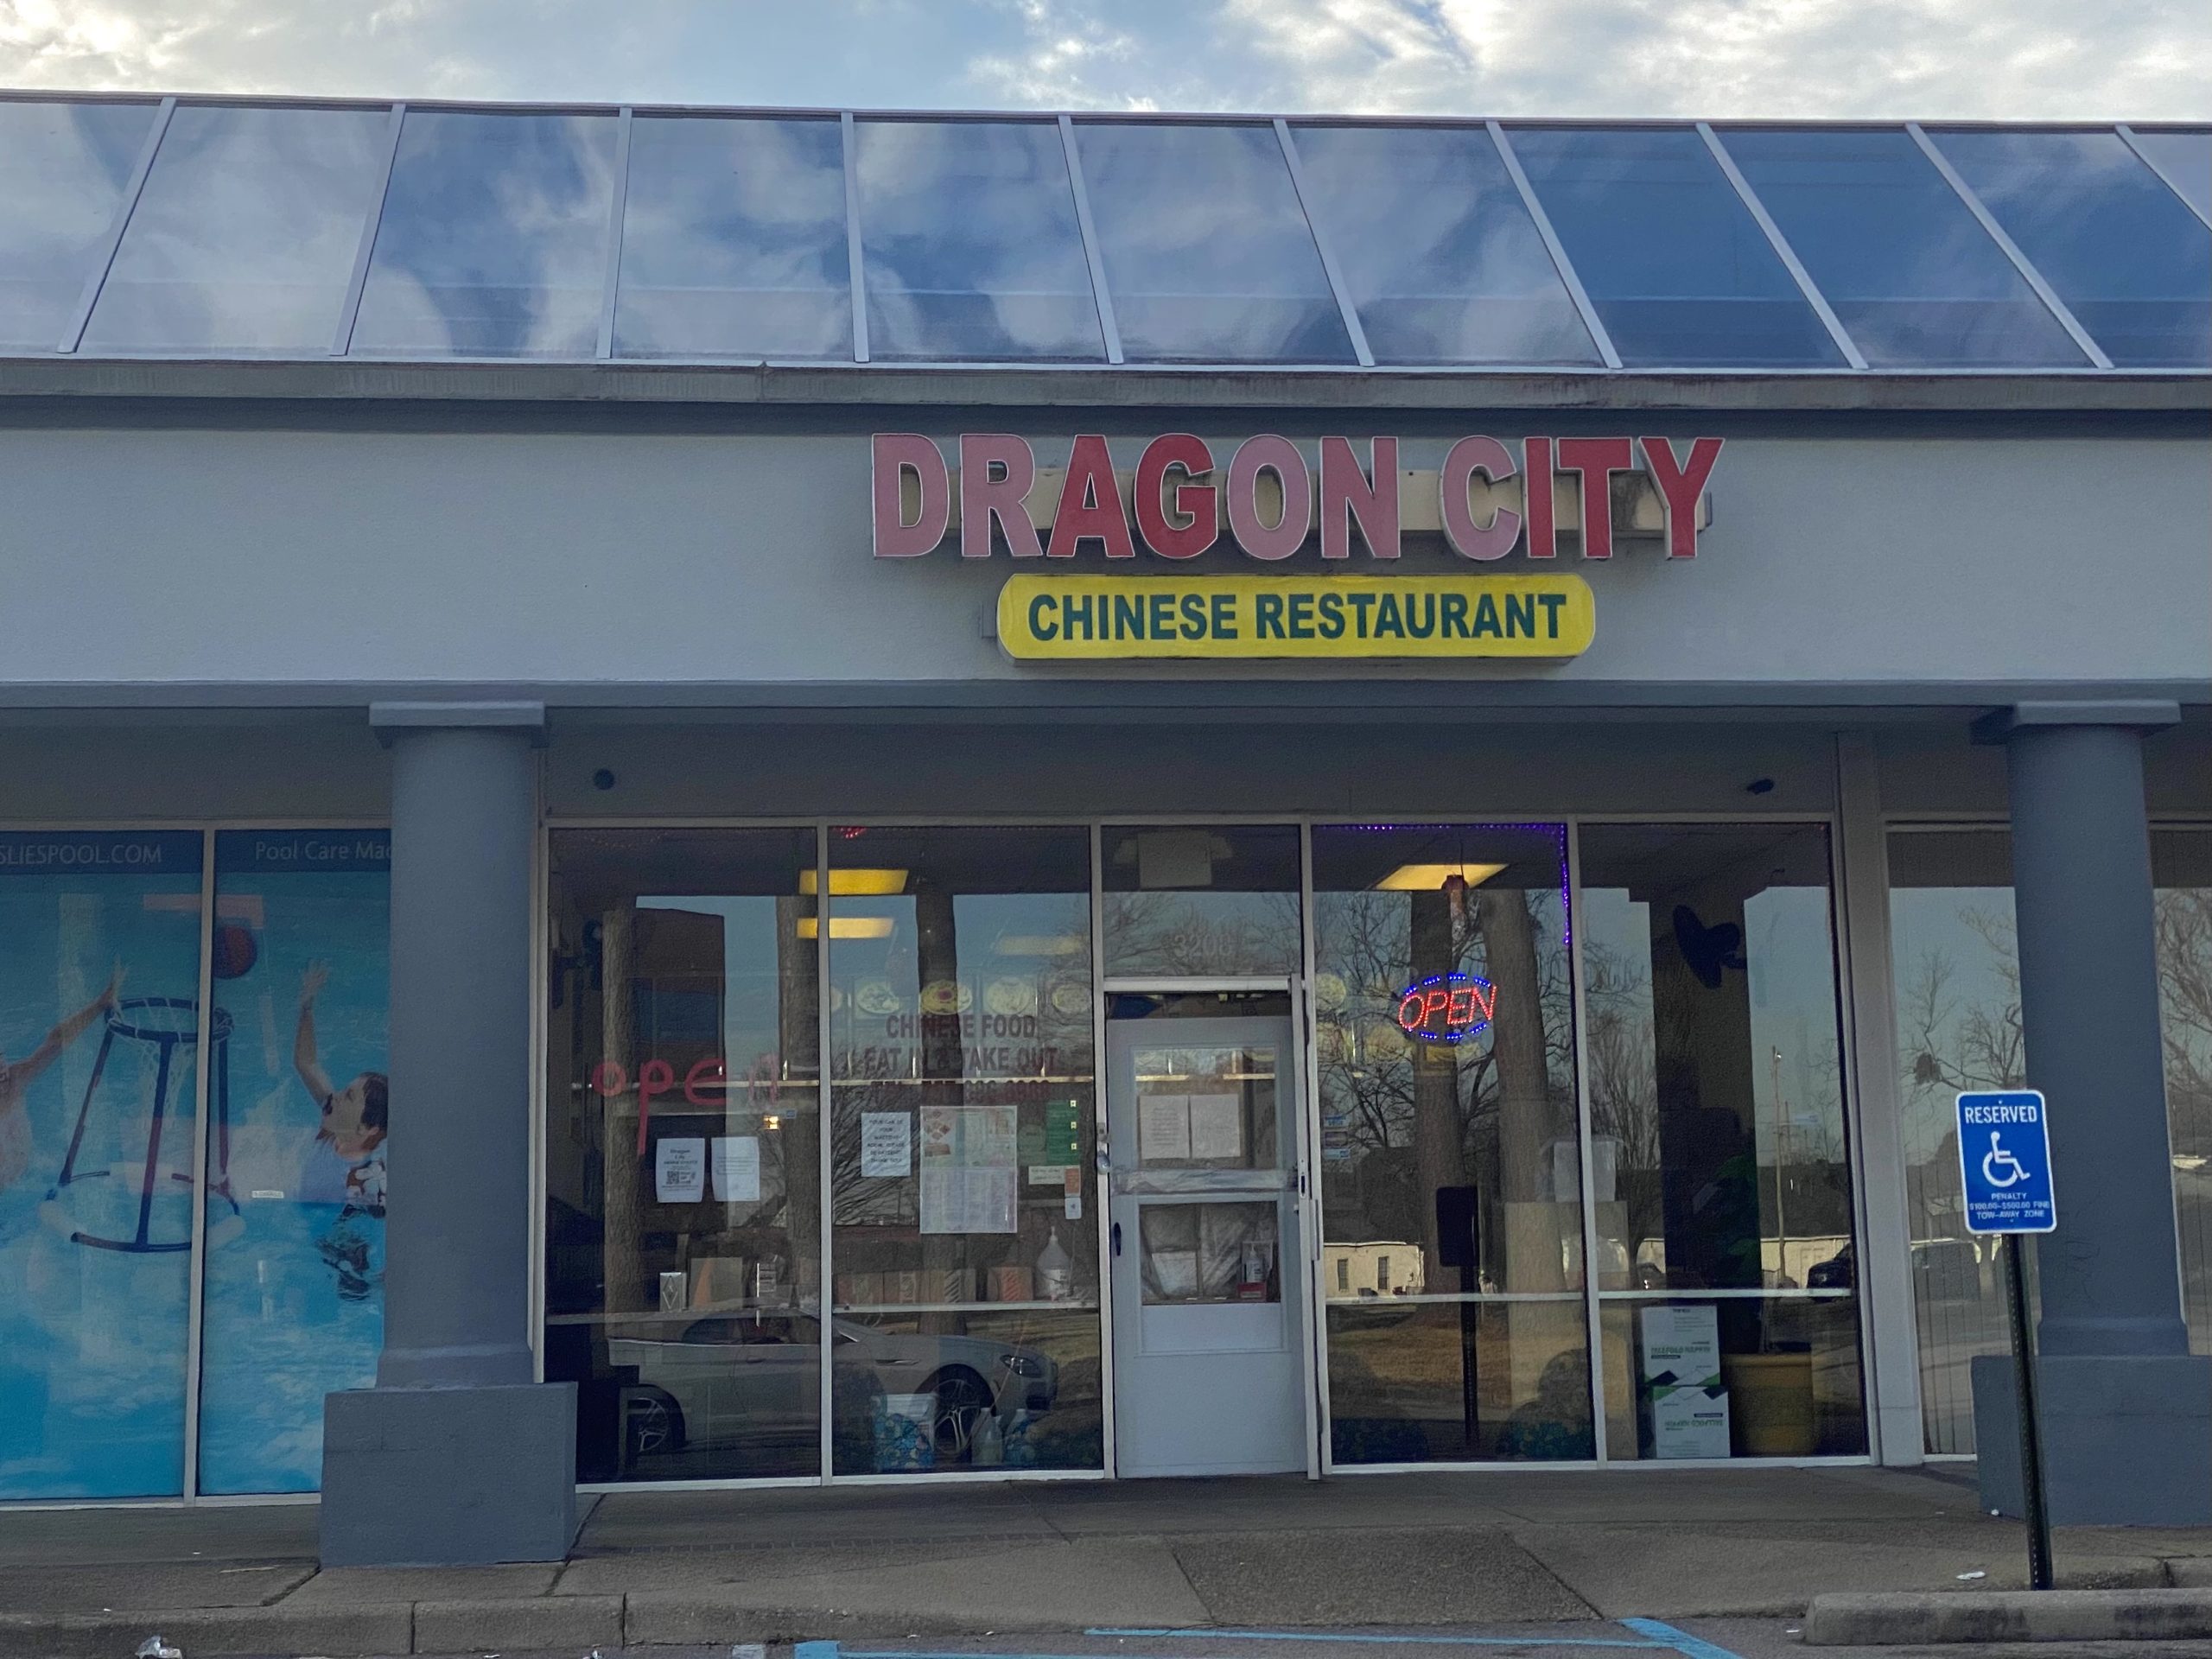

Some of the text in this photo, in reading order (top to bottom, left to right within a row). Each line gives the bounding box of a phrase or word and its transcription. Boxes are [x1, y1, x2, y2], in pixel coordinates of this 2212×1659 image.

[871, 433, 1727, 562] DRAGON CITY
[1027, 592, 1568, 642] CHINESE RESTAURANT
[255, 840, 298, 861] Pool
[305, 841, 349, 861] Care
[1398, 984, 1497, 1032] OPEN
[886, 1014, 1036, 1039] CHINESE FOOD
[864, 1046, 901, 1071] EAT
[961, 1046, 1010, 1071] TAKE
[1016, 1046, 1058, 1071] OUT
[592, 1052, 780, 1159] open
[1964, 1106, 2037, 1124] RESERVED
[1991, 1192, 2027, 1201] PENALTY
[1976, 1211, 2019, 1220] TOW-AWAY
